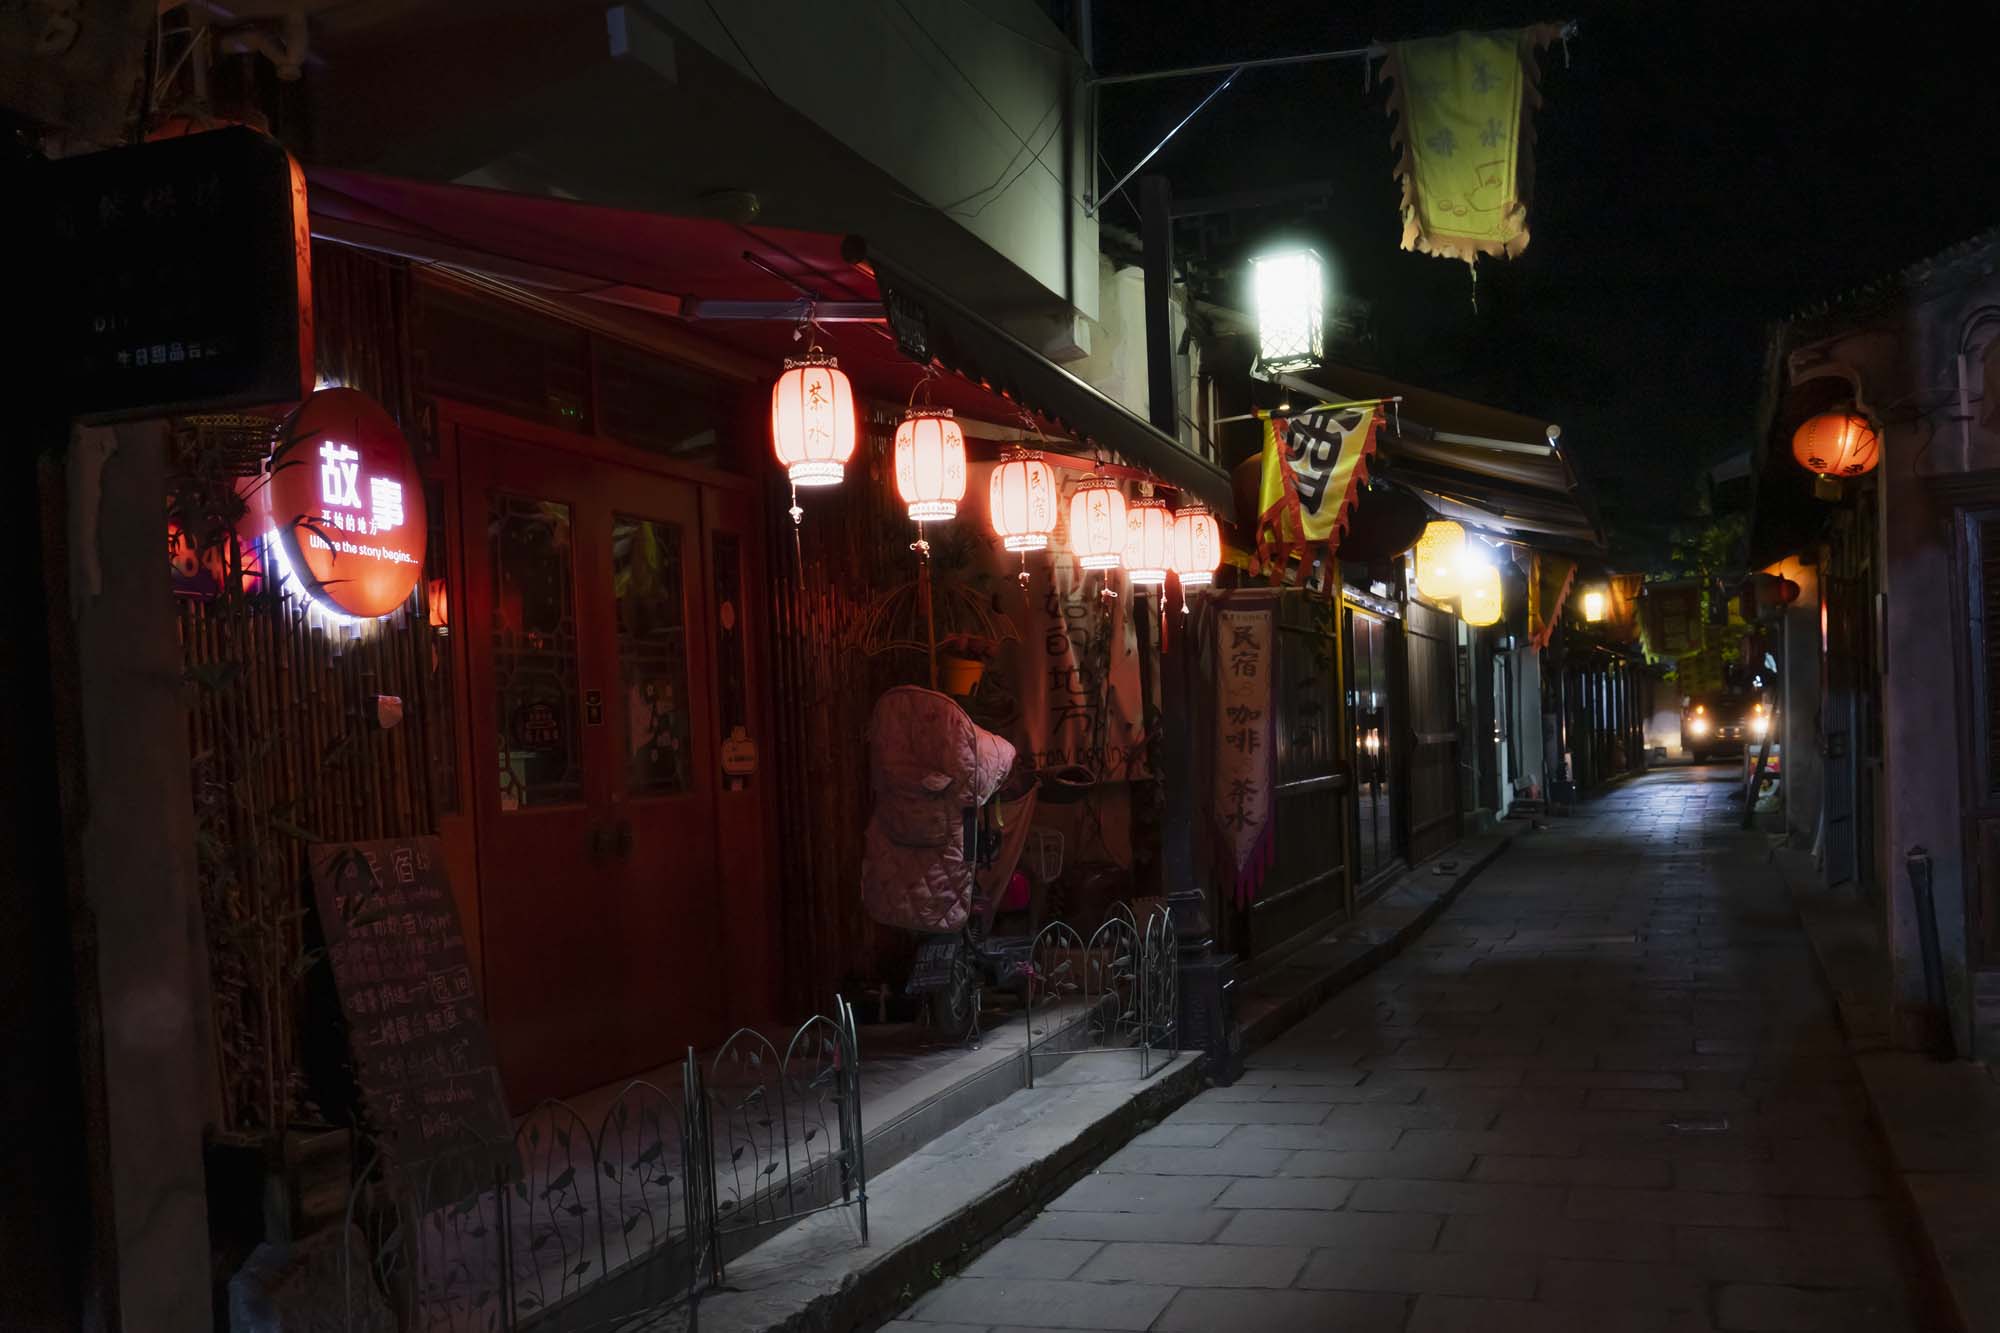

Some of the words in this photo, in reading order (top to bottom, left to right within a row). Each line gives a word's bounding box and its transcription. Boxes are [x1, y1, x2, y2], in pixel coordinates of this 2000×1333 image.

[807, 380, 830, 446] 茶水
[319, 440, 404, 531] 故事
[321, 509, 380, 537] 开始的地方
[342, 540, 358, 554] the
[359, 545, 382, 561] story
[382, 546, 419, 565] begins...
[1229, 625, 1260, 678] 民宿
[1225, 704, 1262, 755] 咖啡
[1225, 777, 1260, 833] 茶水
